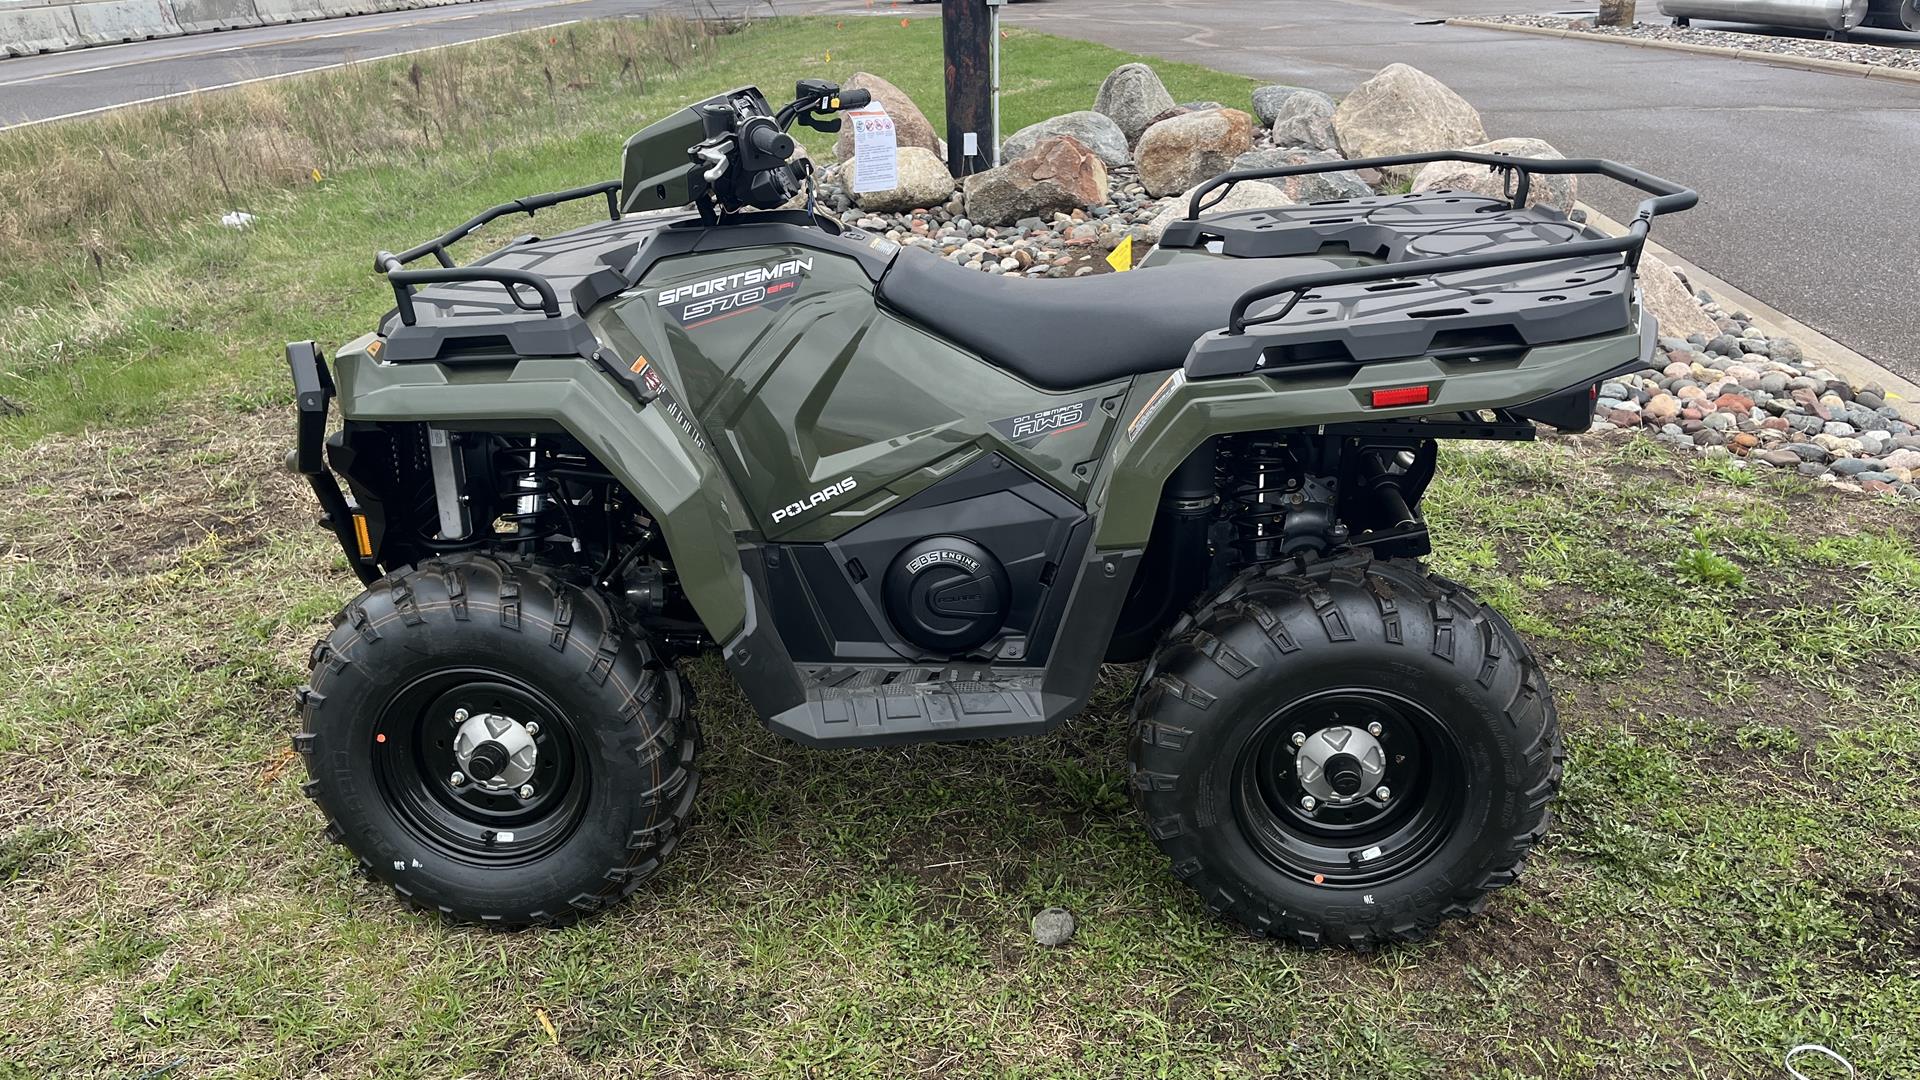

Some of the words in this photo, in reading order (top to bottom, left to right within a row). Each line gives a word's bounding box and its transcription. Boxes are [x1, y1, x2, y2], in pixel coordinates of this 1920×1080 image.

[657, 257, 813, 306] SPORTSMAN
[683, 286, 765, 321] 570
[1012, 409, 1082, 437] AWD
[1013, 415, 1031, 424] ON
[1034, 403, 1083, 418] DEMAND
[771, 476, 857, 523] POLARIS
[910, 552, 939, 570] EBS
[941, 551, 978, 569] ENGINE
